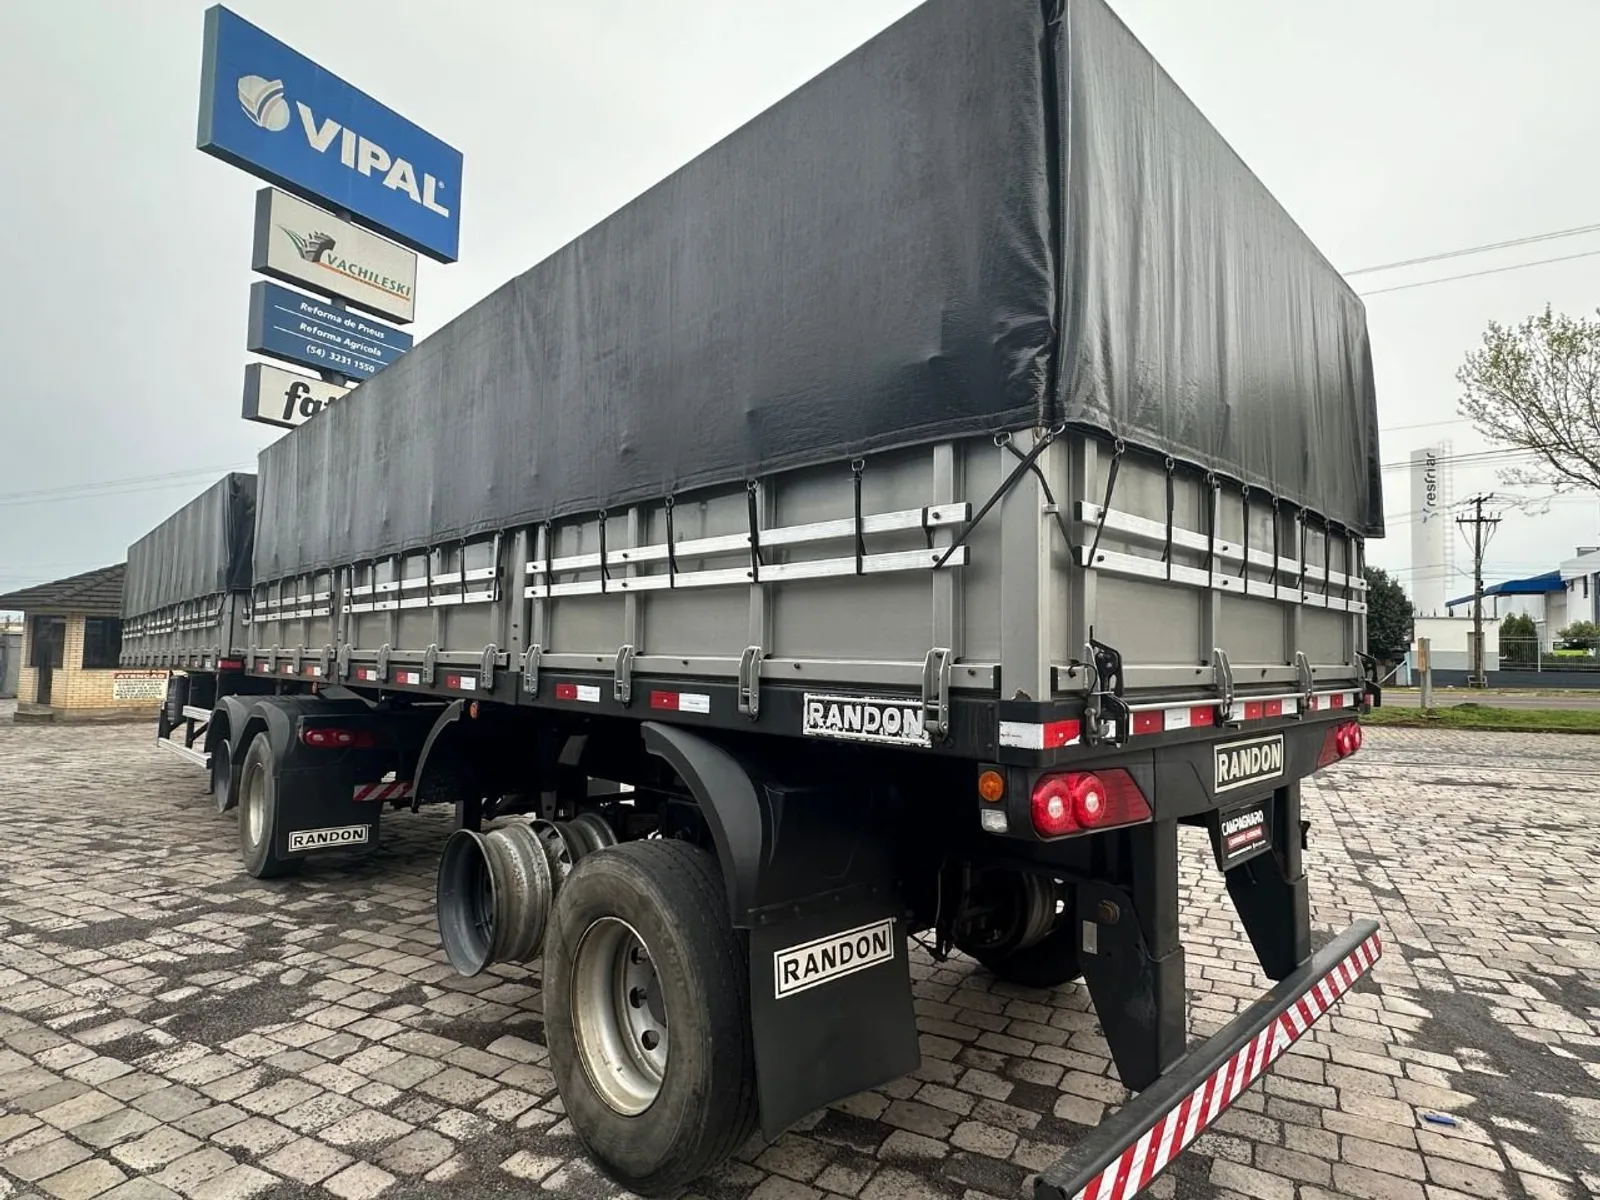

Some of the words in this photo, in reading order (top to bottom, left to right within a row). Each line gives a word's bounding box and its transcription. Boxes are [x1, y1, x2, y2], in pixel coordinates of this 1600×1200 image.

[296, 100, 449, 218] VIPAL
[327, 253, 411, 296] VACHILESKI
[300, 302, 342, 323] Reforma
[344, 319, 356, 328] de
[358, 323, 385, 339] Pneus
[300, 322, 342, 343] Reforma
[306, 344, 326, 358] (54)
[329, 351, 351, 365] 3231
[354, 360, 375, 373] 1550
[1424, 452, 1436, 507] resfriar
[808, 702, 924, 735] RANDON
[1218, 743, 1281, 782] RANDON
[293, 829, 363, 846] RANDON
[783, 929, 888, 984] RANDON
